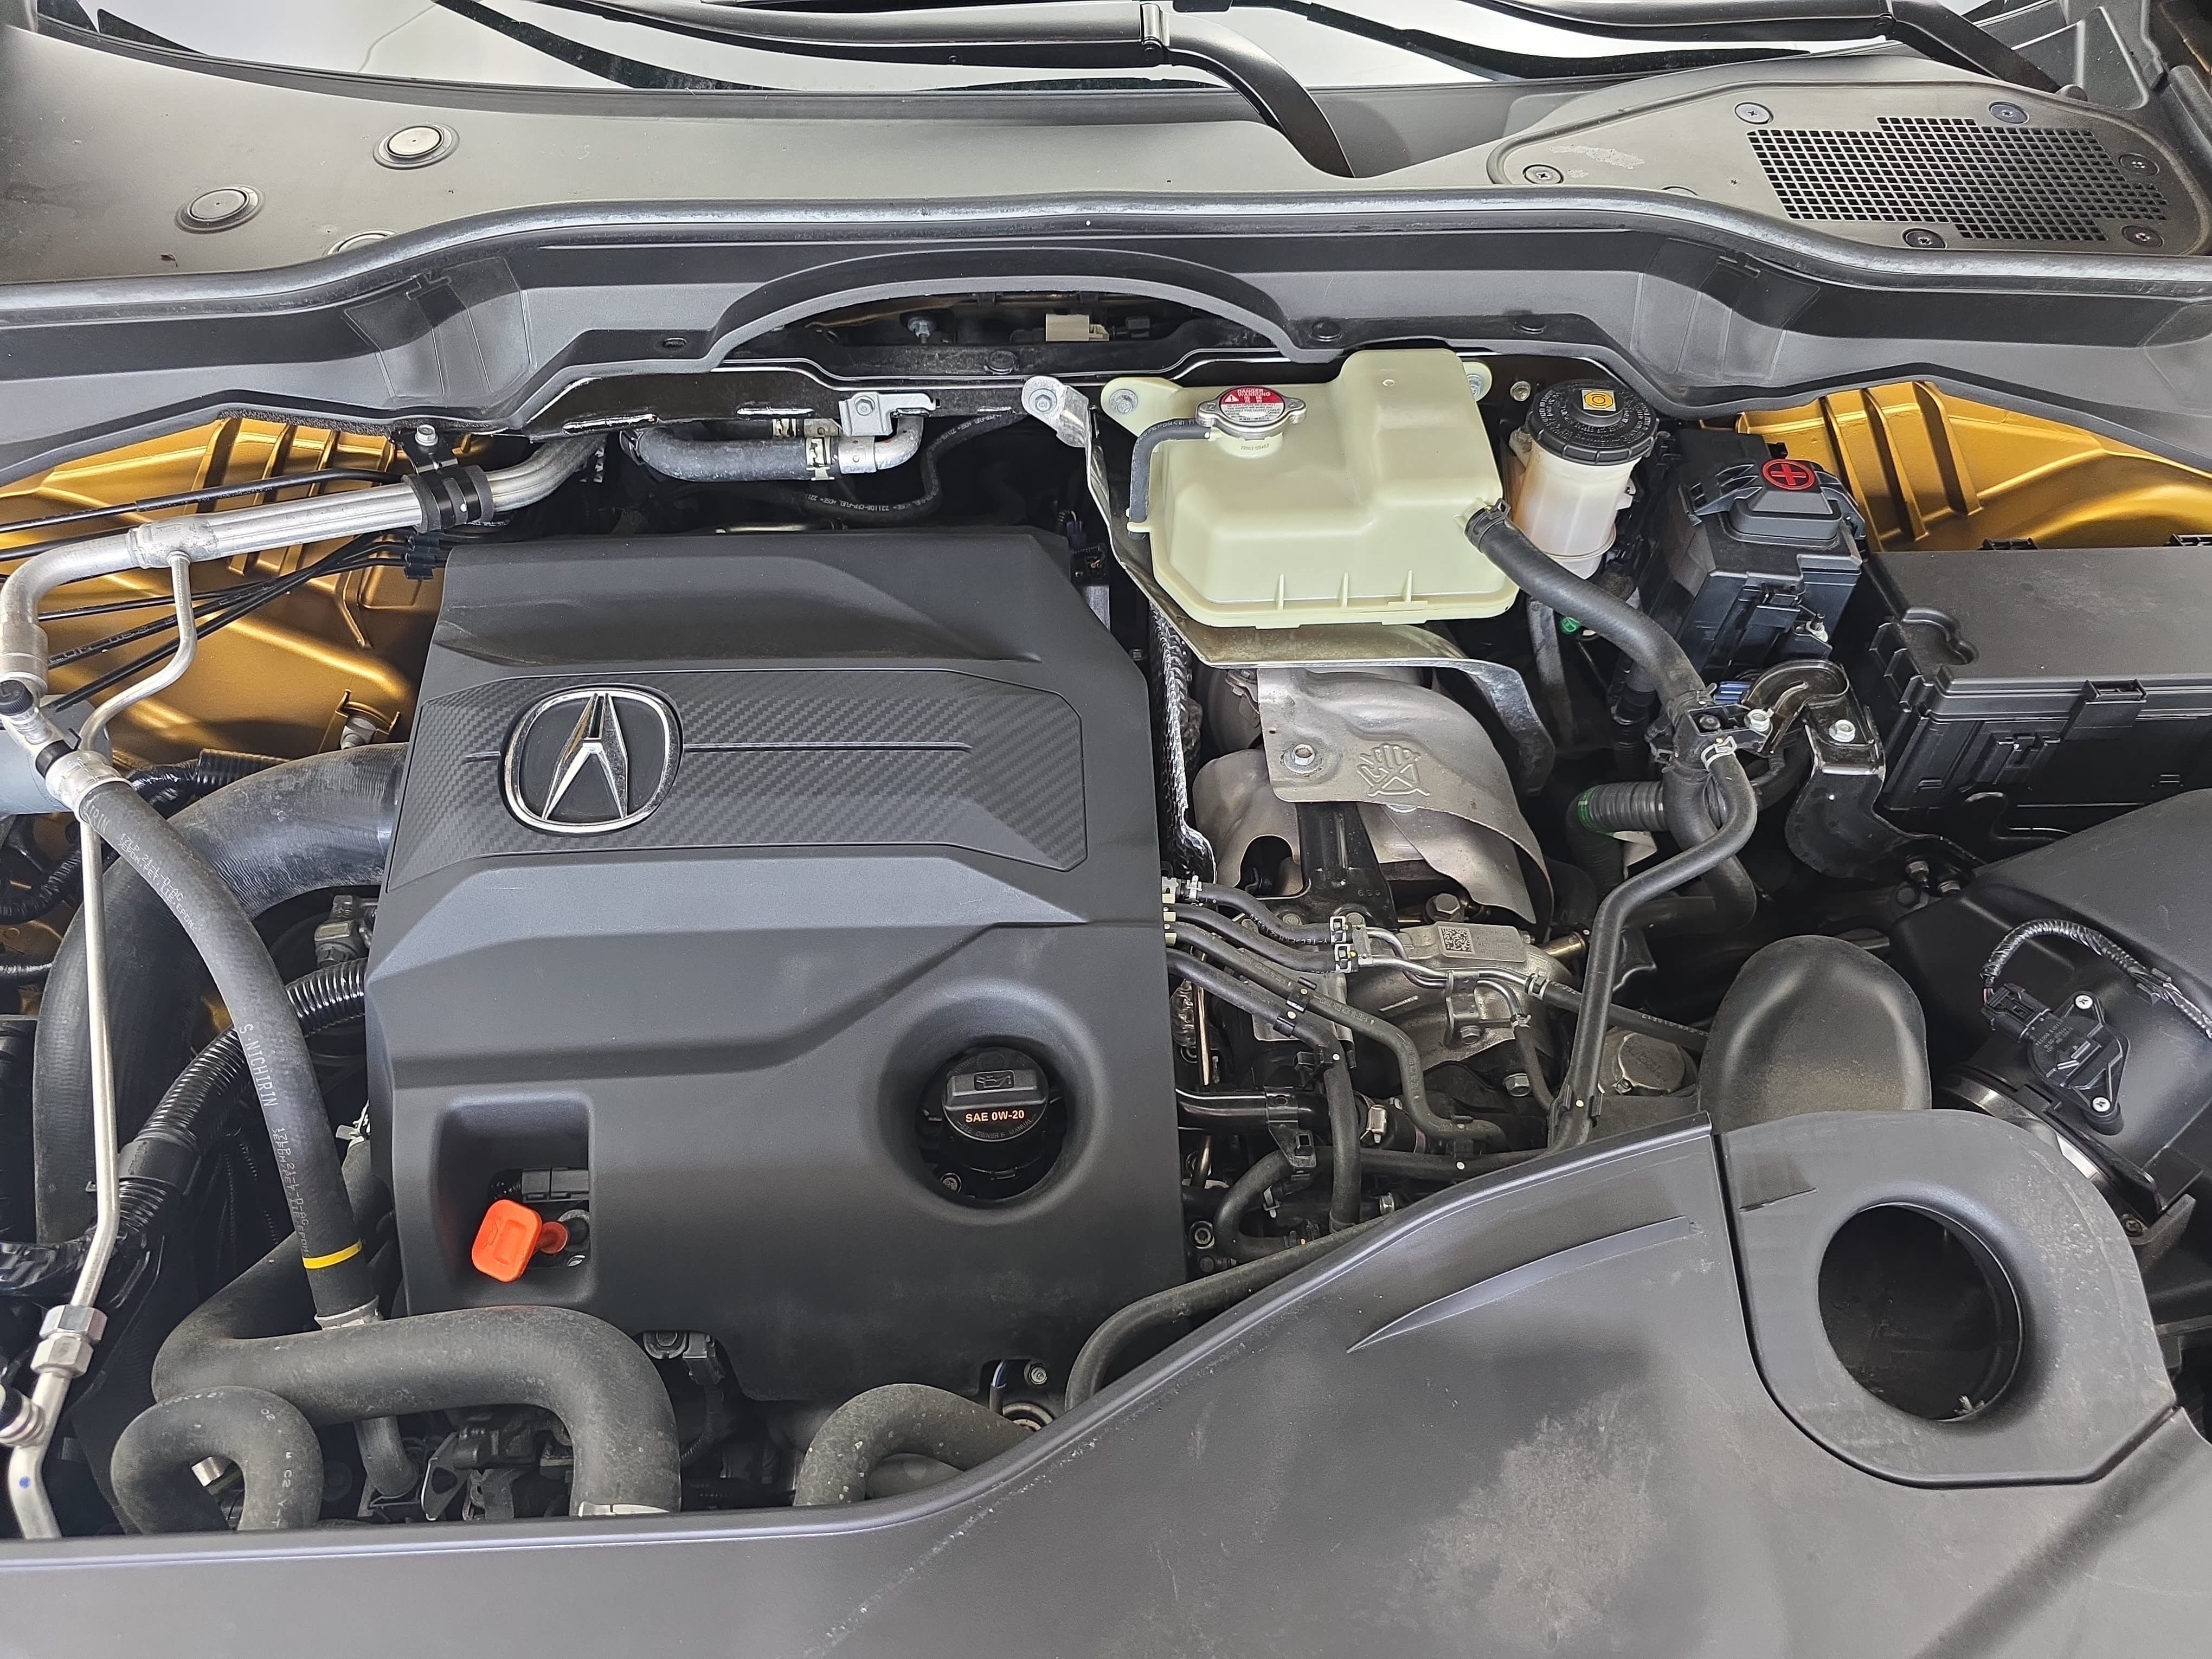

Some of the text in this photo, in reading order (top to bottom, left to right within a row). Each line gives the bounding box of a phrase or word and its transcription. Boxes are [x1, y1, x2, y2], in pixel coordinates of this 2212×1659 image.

[246, 1037, 280, 1108] NICHIRIN
[965, 1110, 1025, 1122] SAE 0W-20
